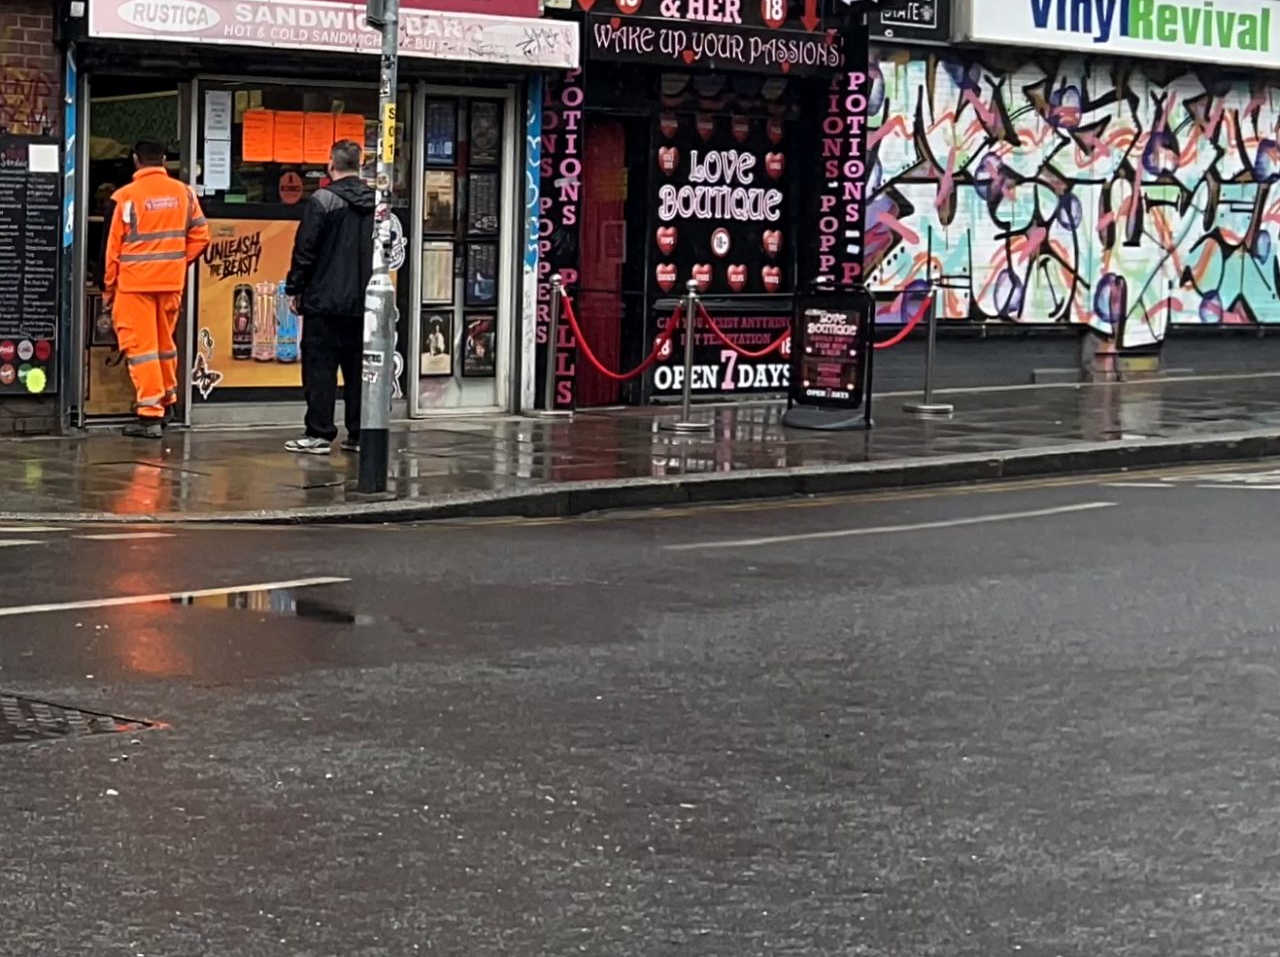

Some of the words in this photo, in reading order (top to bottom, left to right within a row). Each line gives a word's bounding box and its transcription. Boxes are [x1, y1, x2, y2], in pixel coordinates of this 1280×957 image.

[131, 1, 210, 27] RUSTICA
[234, 3, 373, 31] SANDWIC
[223, 23, 252, 37] HOT
[256, 27, 266, 38] &
[270, 27, 308, 42] COLD
[312, 28, 382, 48] SANDWICH
[842, 71, 867, 223] POTIONS
[203, 231, 261, 265] UNLEASH
[654, 365, 719, 390] OPEN
[720, 350, 738, 390] 7
[737, 364, 791, 389] DAYS
